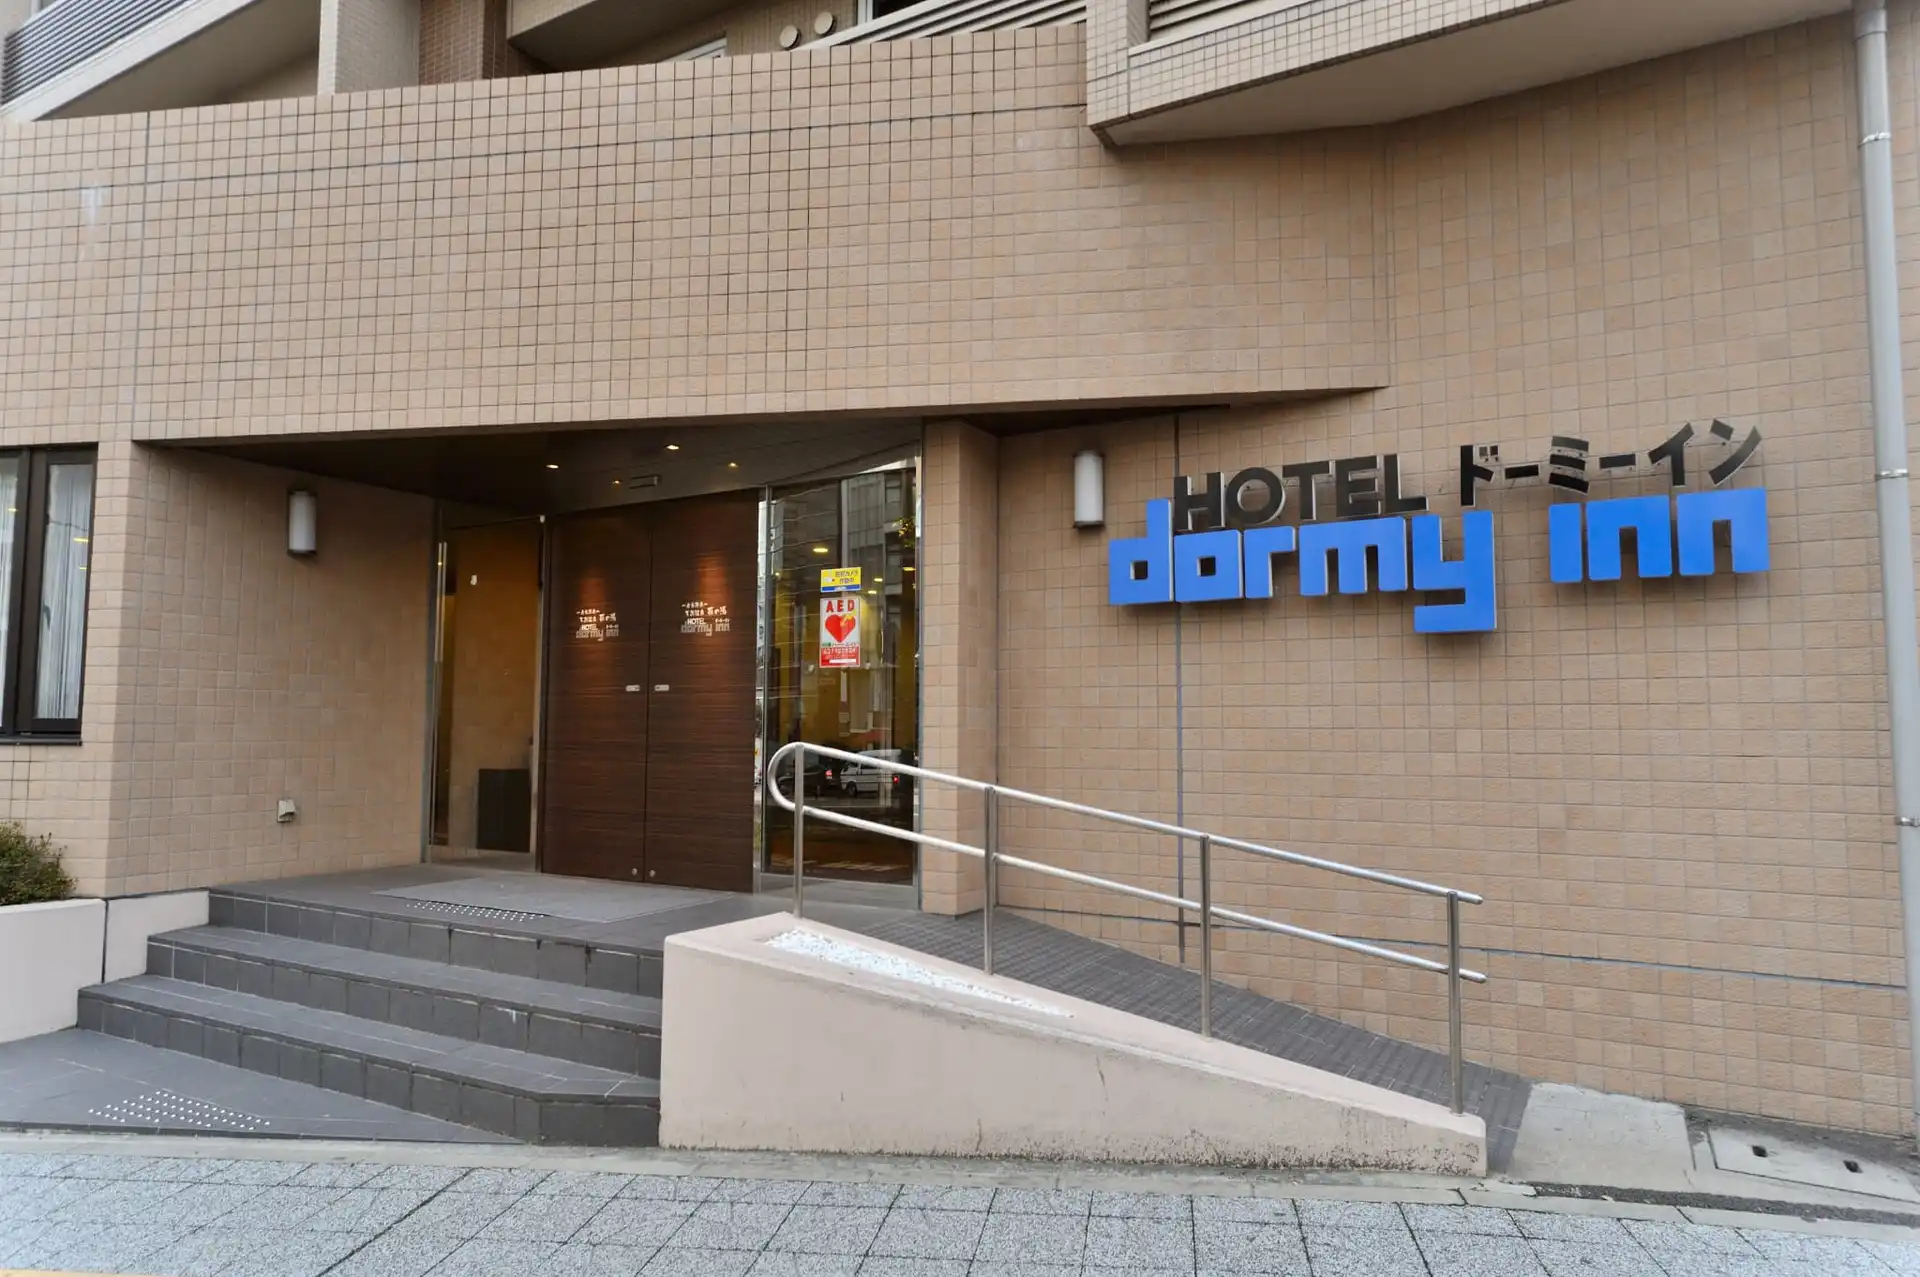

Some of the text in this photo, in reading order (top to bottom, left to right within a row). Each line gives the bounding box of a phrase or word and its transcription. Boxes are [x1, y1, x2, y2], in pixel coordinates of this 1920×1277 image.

[1460, 418, 1762, 508] ドーミーイン
[1173, 454, 1428, 531] HOTEL
[1109, 487, 1770, 633] dormy inn
[826, 599, 855, 613] AED
[581, 623, 598, 631] HOTEL
[681, 620, 730, 636] dormy inn
[687, 617, 706, 625] HOTEL
[576, 627, 604, 642] dormy
